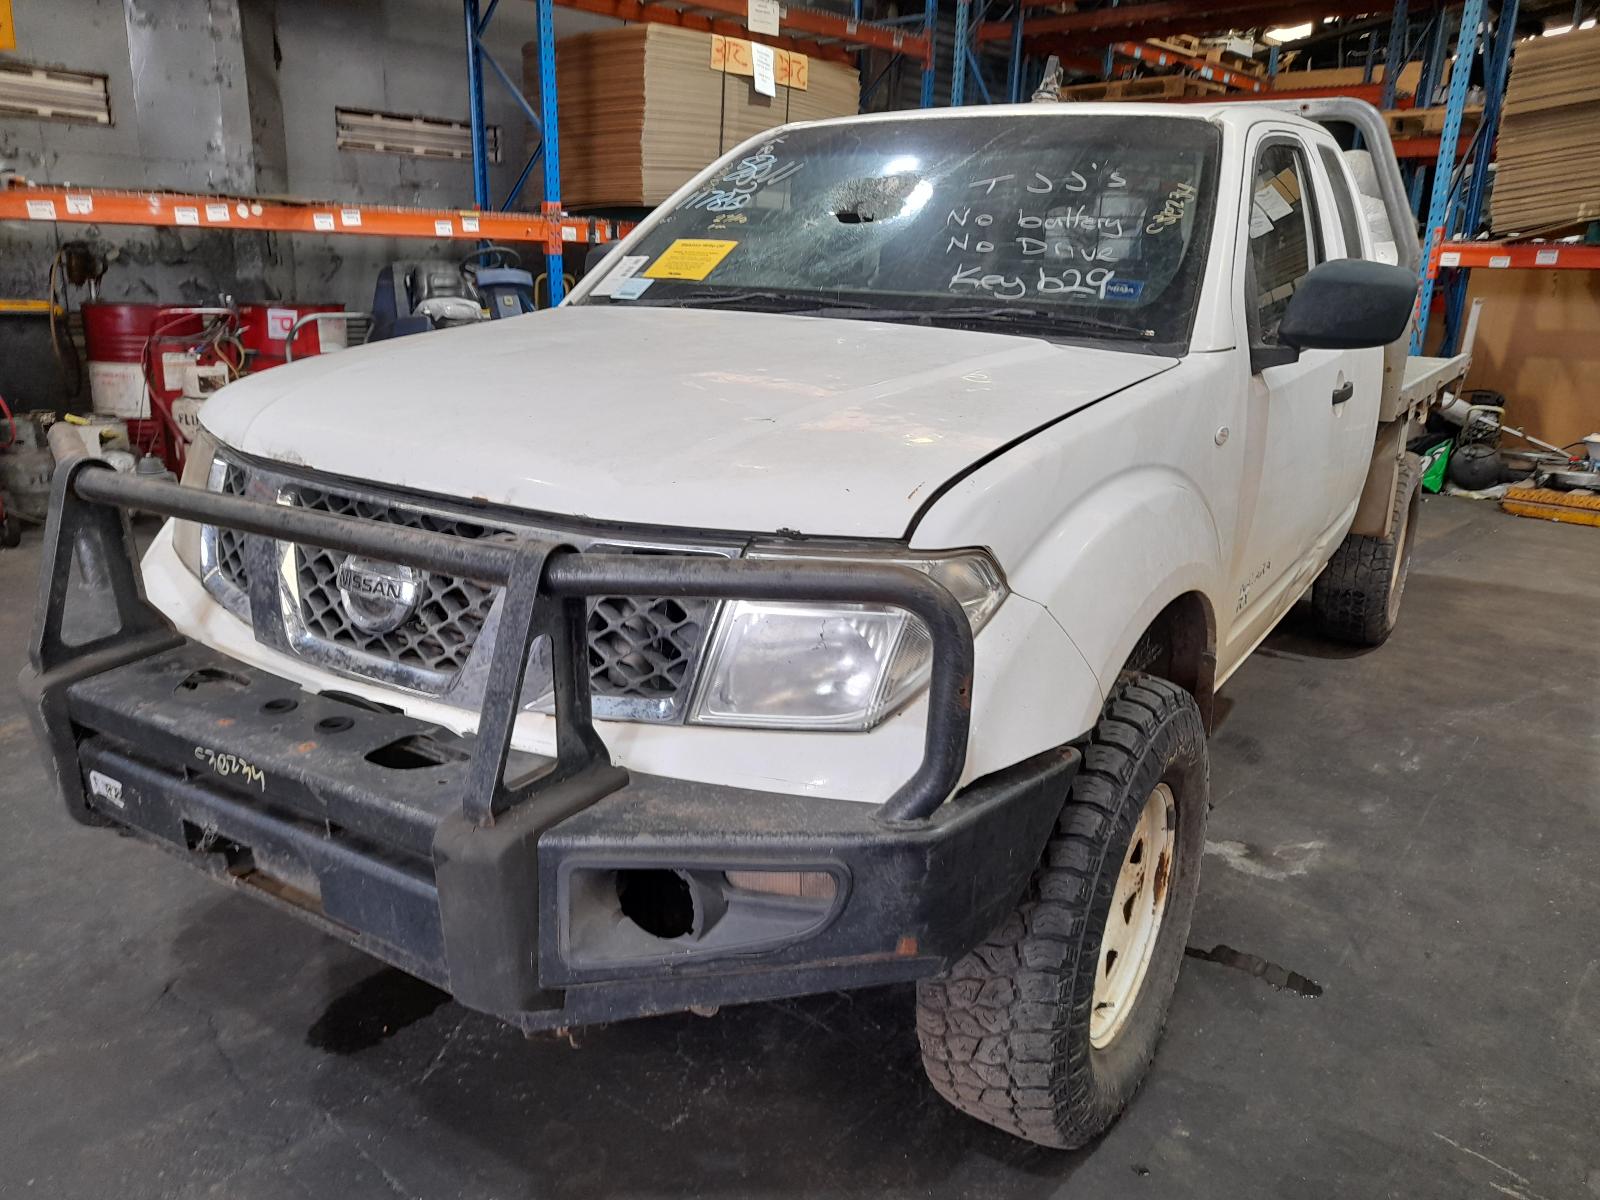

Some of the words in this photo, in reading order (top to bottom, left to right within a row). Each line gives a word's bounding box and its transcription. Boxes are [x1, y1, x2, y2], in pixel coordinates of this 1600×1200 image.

[946, 207, 993, 227] No
[946, 233, 995, 254] No
[948, 263, 1026, 300] Key
[340, 569, 400, 599] NISSAN
